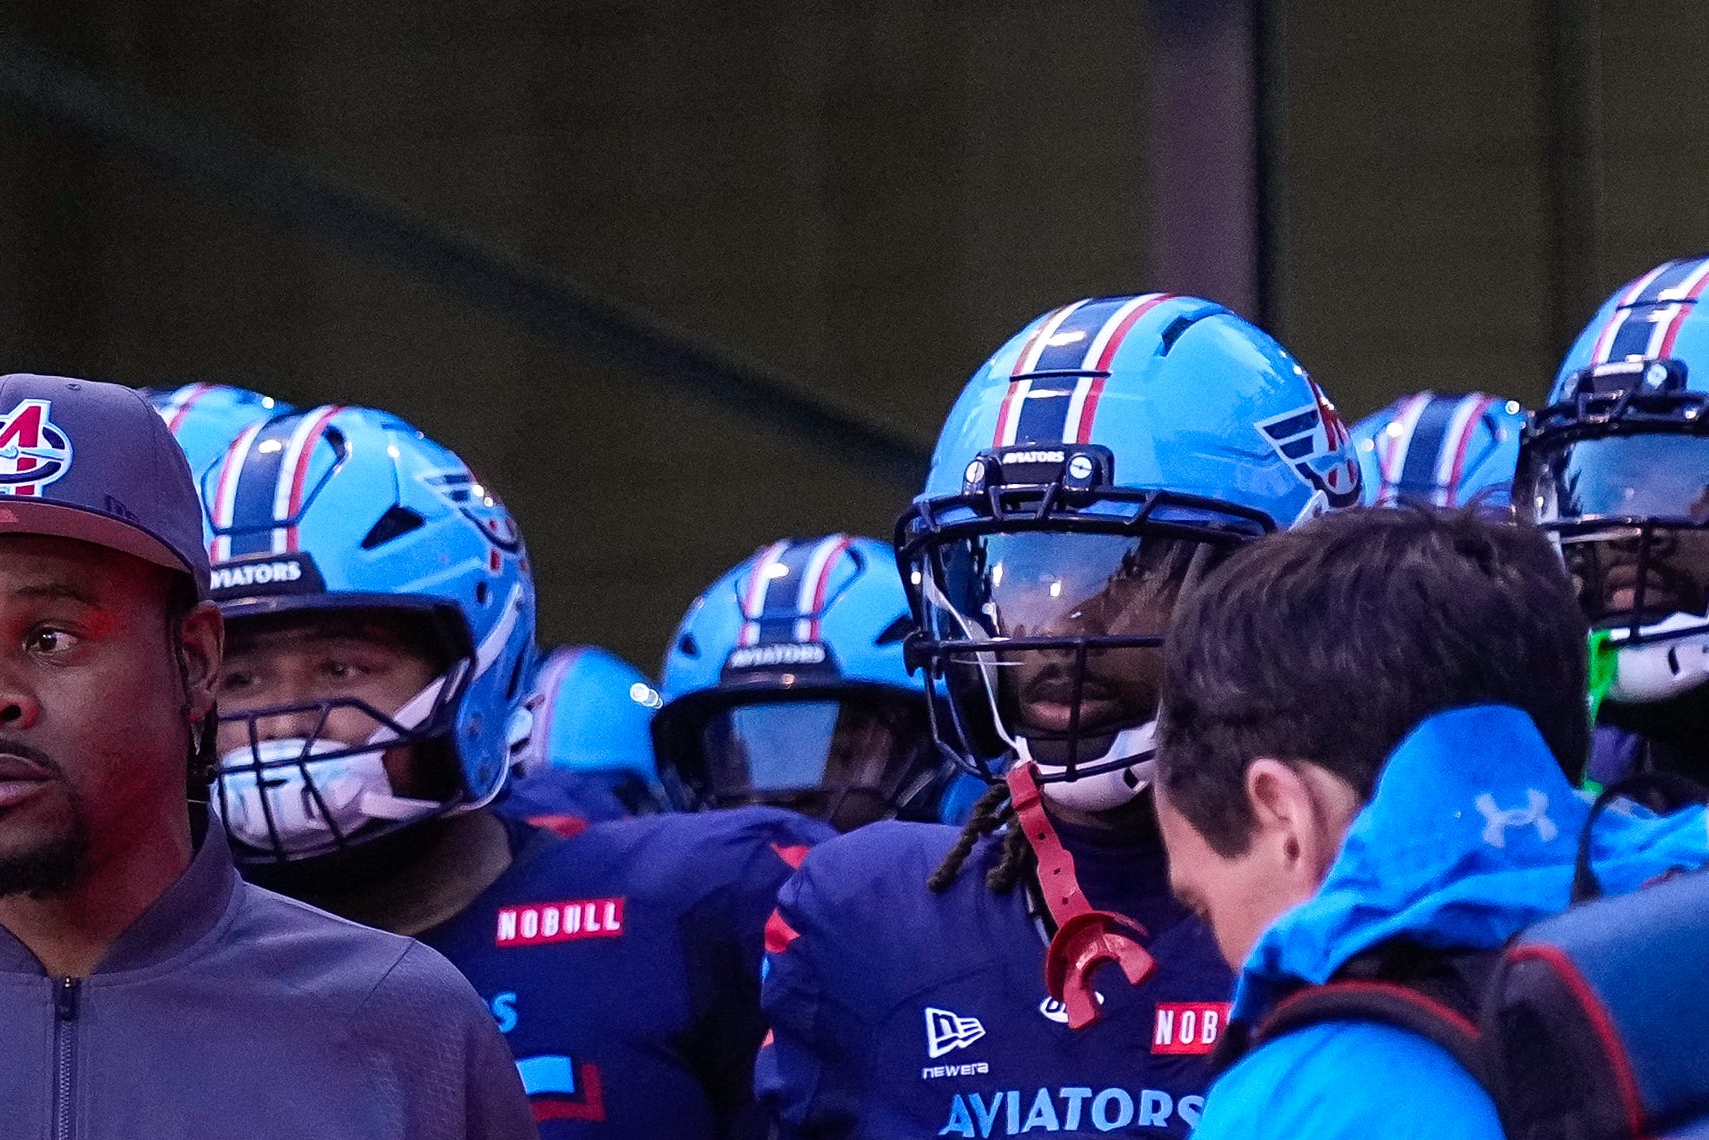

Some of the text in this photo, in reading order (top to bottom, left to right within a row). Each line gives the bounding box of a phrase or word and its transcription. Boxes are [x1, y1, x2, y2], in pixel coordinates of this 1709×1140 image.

[1003, 451, 1065, 465] AVIATORS
[210, 561, 302, 591] VIATORS
[497, 901, 621, 941] NOBULL
[1155, 1009, 1219, 1046] NOB
[937, 1087, 1206, 1139] AVIATORS
